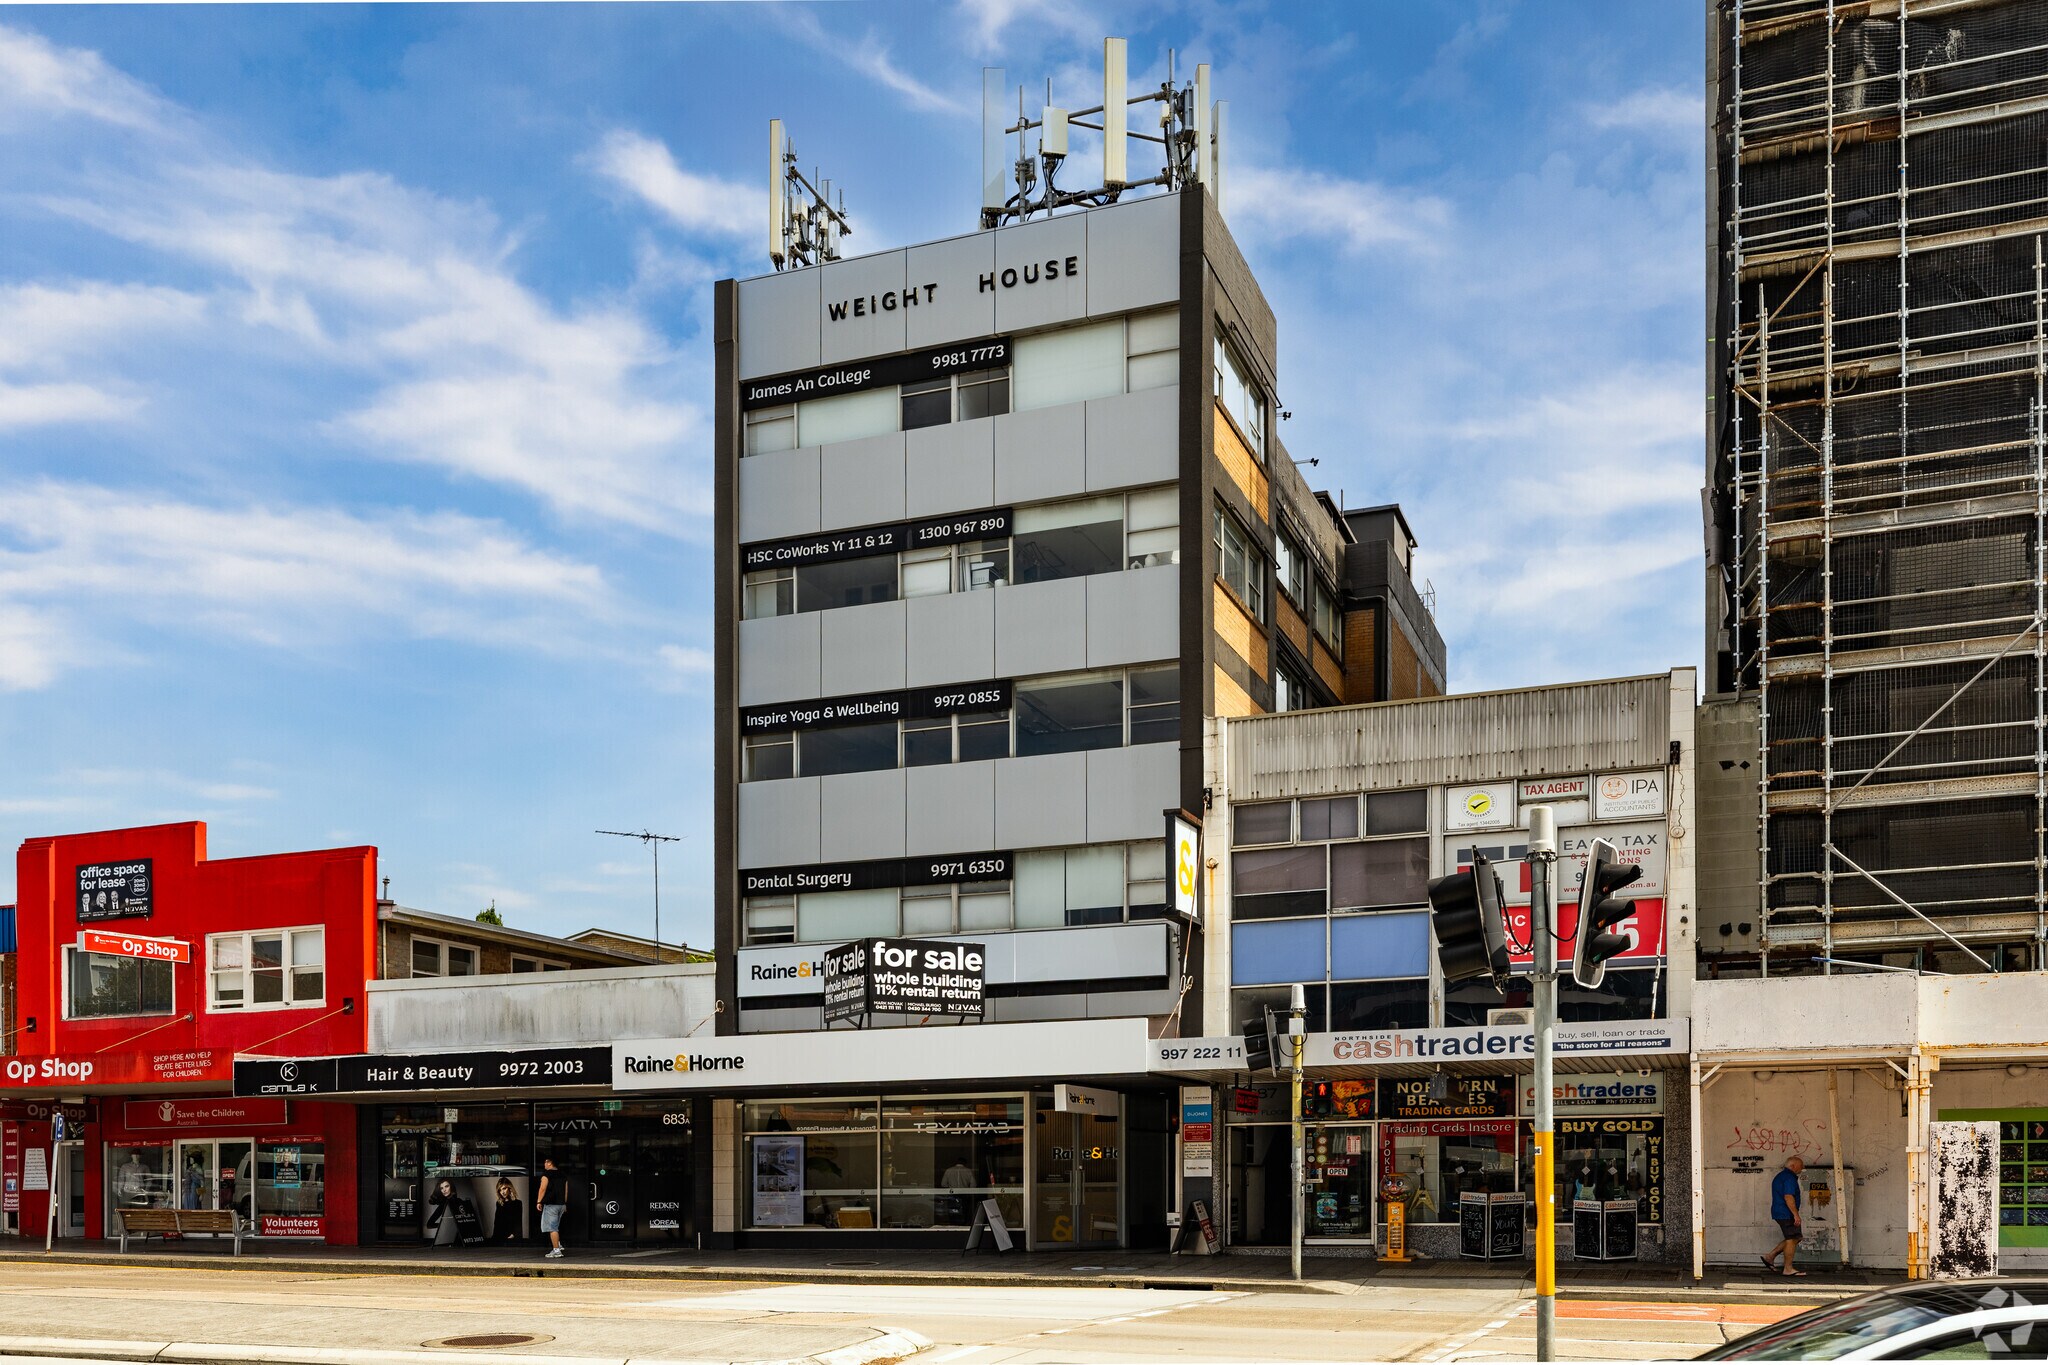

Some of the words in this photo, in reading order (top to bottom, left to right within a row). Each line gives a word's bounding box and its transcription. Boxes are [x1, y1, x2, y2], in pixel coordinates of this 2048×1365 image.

[828, 282, 938, 322] WEIGHT
[978, 256, 1078, 294] HOUSE
[932, 349, 968, 370] 9981
[970, 344, 1004, 362] 7773
[748, 381, 792, 401] James
[795, 376, 814, 392] An
[817, 367, 872, 391] College
[919, 525, 951, 540] 1300
[954, 521, 978, 536] 967
[980, 516, 1005, 532] 890
[747, 548, 773, 564] HSC
[775, 540, 829, 560] CoWorks
[832, 537, 846, 552] Yr
[848, 536, 862, 549] 11
[864, 534, 876, 548] &
[878, 532, 893, 546] 12
[934, 694, 966, 709] 9972
[968, 690, 1000, 706] 0855
[746, 710, 788, 730] Inspire
[790, 708, 820, 725] Yoga
[823, 706, 834, 719] &
[836, 699, 899, 720] Wellbeing
[1524, 784, 1544, 796] TAX
[1546, 781, 1584, 794] AGENT
[1632, 779, 1658, 794] IPA
[1604, 804, 1656, 813] ACCOUNTANTS
[1622, 834, 1658, 846] TAX
[80, 866, 112, 878] office
[114, 864, 146, 876] space
[930, 862, 965, 878] 9971
[968, 859, 1004, 874] 6350
[80, 879, 96, 890] for
[98, 877, 126, 889] lease
[747, 873, 794, 890] Dental
[796, 870, 852, 890] Surgery
[122, 940, 143, 956] Op
[145, 942, 178, 960] Shop
[873, 940, 918, 968] for
[924, 946, 982, 972] sale
[824, 954, 841, 978] for
[842, 944, 865, 973] sale
[752, 961, 824, 980] Raine&H
[825, 980, 842, 994] whole
[842, 974, 864, 989] building
[874, 971, 920, 986] whole
[923, 973, 982, 990] building
[875, 984, 897, 996] 11%
[901, 986, 938, 998] rental
[941, 988, 981, 1000] return
[1161, 1048, 1188, 1060] 997
[1193, 1048, 1221, 1059] 222
[1227, 1047, 1242, 1058] 11
[1333, 1032, 1535, 1060] cashtraders
[153, 1055, 168, 1063] SHOP
[624, 1054, 744, 1074] Raine&Horne
[6, 1060, 36, 1084] Op
[41, 1058, 93, 1081] Shop
[367, 1068, 398, 1081] Hair
[403, 1068, 414, 1080] &
[419, 1066, 473, 1080] Beauty
[500, 1062, 538, 1077] 9972
[544, 1060, 584, 1075] 2003
[310, 1084, 317, 1092] K
[1526, 1082, 1657, 1099] cshtraders
[1407, 1093, 1486, 1106] BEAES
[27, 1104, 48, 1119] Op
[52, 1105, 87, 1119] Shop
[197, 1109, 209, 1117] the
[211, 1109, 245, 1117] Children
[1398, 1106, 1451, 1115] TRADING
[1455, 1105, 1495, 1114] CARDS
[1384, 1124, 1428, 1135] Trading
[1432, 1124, 1465, 1132] Cards
[1470, 1123, 1512, 1132] Instore
[1562, 1122, 1598, 1133] BUY
[1602, 1121, 1654, 1132] GOLD
[1648, 1137, 1661, 1154] WE
[1650, 1158, 1659, 1183] BUY
[1649, 1187, 1660, 1220] GOLD
[266, 1218, 318, 1227] Volunteers
